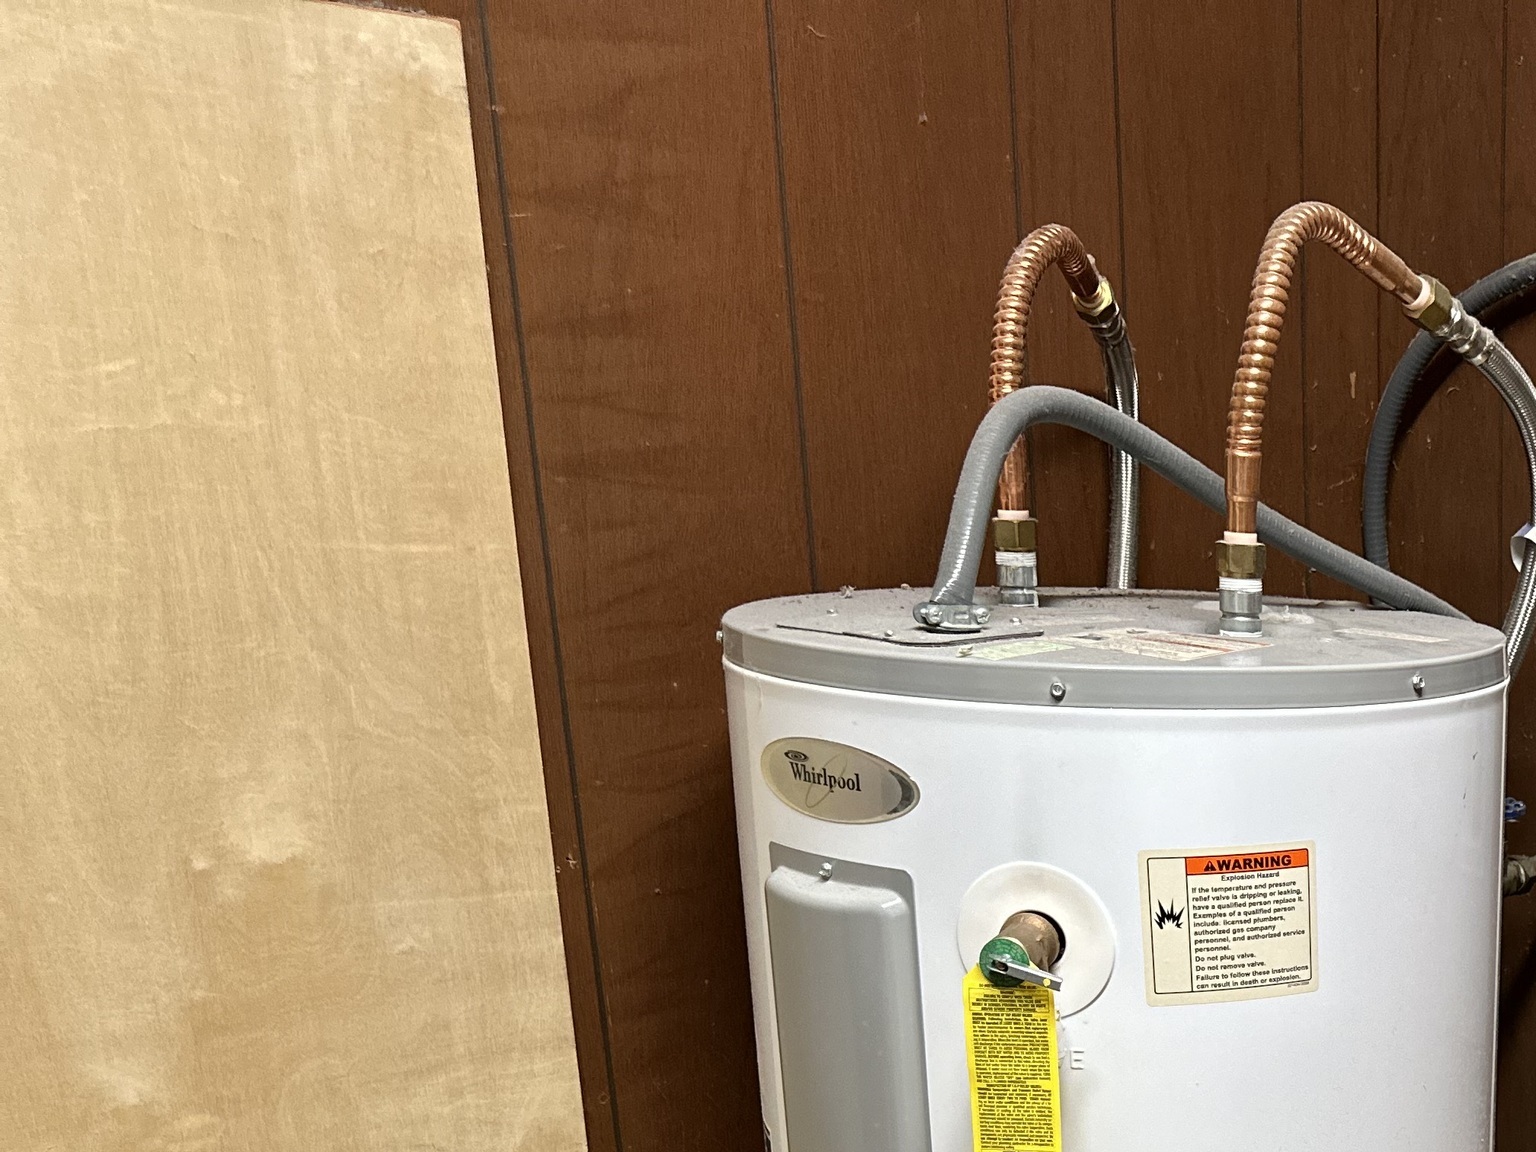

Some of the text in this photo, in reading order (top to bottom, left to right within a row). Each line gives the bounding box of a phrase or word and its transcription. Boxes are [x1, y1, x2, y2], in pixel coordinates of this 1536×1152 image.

[789, 761, 862, 792] Whirlpool
[1216, 854, 1292, 871] WARNING
[1221, 871, 1280, 882] Explosion Hazard
[1211, 885, 1252, 893] temperature
[1268, 881, 1296, 889] pressure
[1192, 894, 1210, 902] relief
[1240, 891, 1267, 900] dripping
[1217, 901, 1246, 910] qualified
[1248, 900, 1271, 908] person
[1273, 897, 1296, 905] replace
[1193, 911, 1226, 919] Examples
[1243, 908, 1271, 916] qualified
[1273, 906, 1295, 914] person
[1223, 917, 1251, 925] licensed
[1194, 928, 1230, 936] authorized
[1247, 931, 1281, 940] authorized
[1195, 945, 1231, 954] personnel.
[1220, 954, 1235, 962] plug
[1272, 965, 1308, 974] instructions
